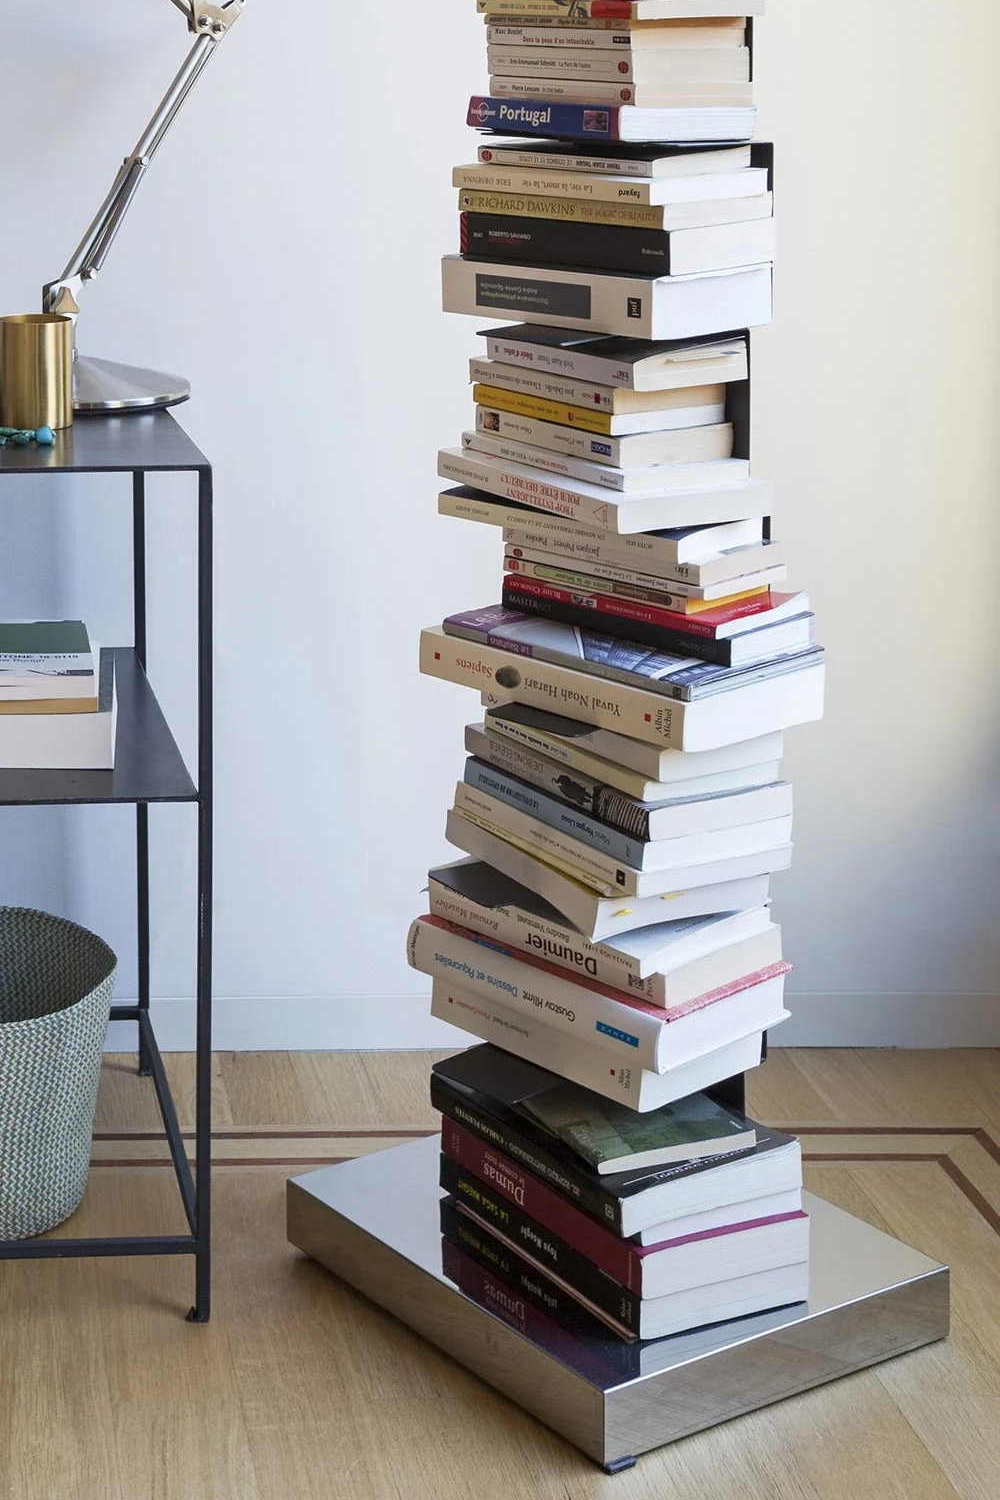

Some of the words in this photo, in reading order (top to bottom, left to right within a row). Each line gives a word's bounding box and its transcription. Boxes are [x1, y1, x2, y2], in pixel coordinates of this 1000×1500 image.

[499, 104, 550, 127] Portugal
[547, 157, 565, 165] COSMOS
[464, 175, 494, 185] ORSENNA
[496, 178, 511, 186] ERIK
[523, 180, 532, 188] vie
[542, 180, 559, 189] mort,
[561, 183, 568, 191] la
[570, 183, 582, 192] vie,
[584, 185, 592, 193] La
[619, 188, 640, 198] fayard
[478, 196, 523, 210] RICHARD
[526, 201, 574, 215] DAWKINS
[581, 207, 592, 215] THE
[595, 208, 616, 217] MAGIC
[618, 210, 627, 218] OF
[628, 211, 656, 221] REALITY
[630, 300, 640, 316] puf
[506, 487, 555, 510] INTELLIGENT
[541, 485, 559, 500] ÊTRE
[561, 491, 580, 505] POUR
[557, 502, 575, 516] TROP
[544, 522, 573, 533] PERMANENT
[575, 528, 598, 538] MEMBRE
[526, 533, 547, 545] Paroles
[554, 539, 574, 551] Prévert
[638, 541, 653, 550] ACTES
[576, 542, 599, 556] Jacques
[542, 588, 561, 599] BLAISE
[491, 635, 518, 652] Bauhaus
[521, 645, 528, 655] Le
[457, 654, 492, 678] Sapiens
[525, 677, 557, 697] Harari
[562, 688, 588, 706] Noah
[593, 696, 620, 716] Yuval
[655, 709, 663, 733] Albin
[664, 708, 672, 738] Michel
[515, 751, 533, 768] BONS
[534, 760, 544, 773] DE
[562, 814, 575, 828] Llosa
[576, 819, 594, 836] Vargas
[595, 830, 610, 845] Mario
[437, 897, 467, 918] Muselier
[470, 911, 498, 931] Renaud
[517, 914, 545, 933] Veronesi
[546, 926, 570, 943] Sandro
[526, 931, 597, 975] Daumier
[599, 947, 632, 968] FANDANGO
[435, 951, 474, 979] Aquarelles
[477, 970, 485, 983] et
[488, 975, 517, 997] Dessins
[523, 990, 543, 1008] Klimt
[545, 999, 575, 1022] Gustav
[483, 1196, 498, 1216] SAGA
[501, 1209, 508, 1224] LA
